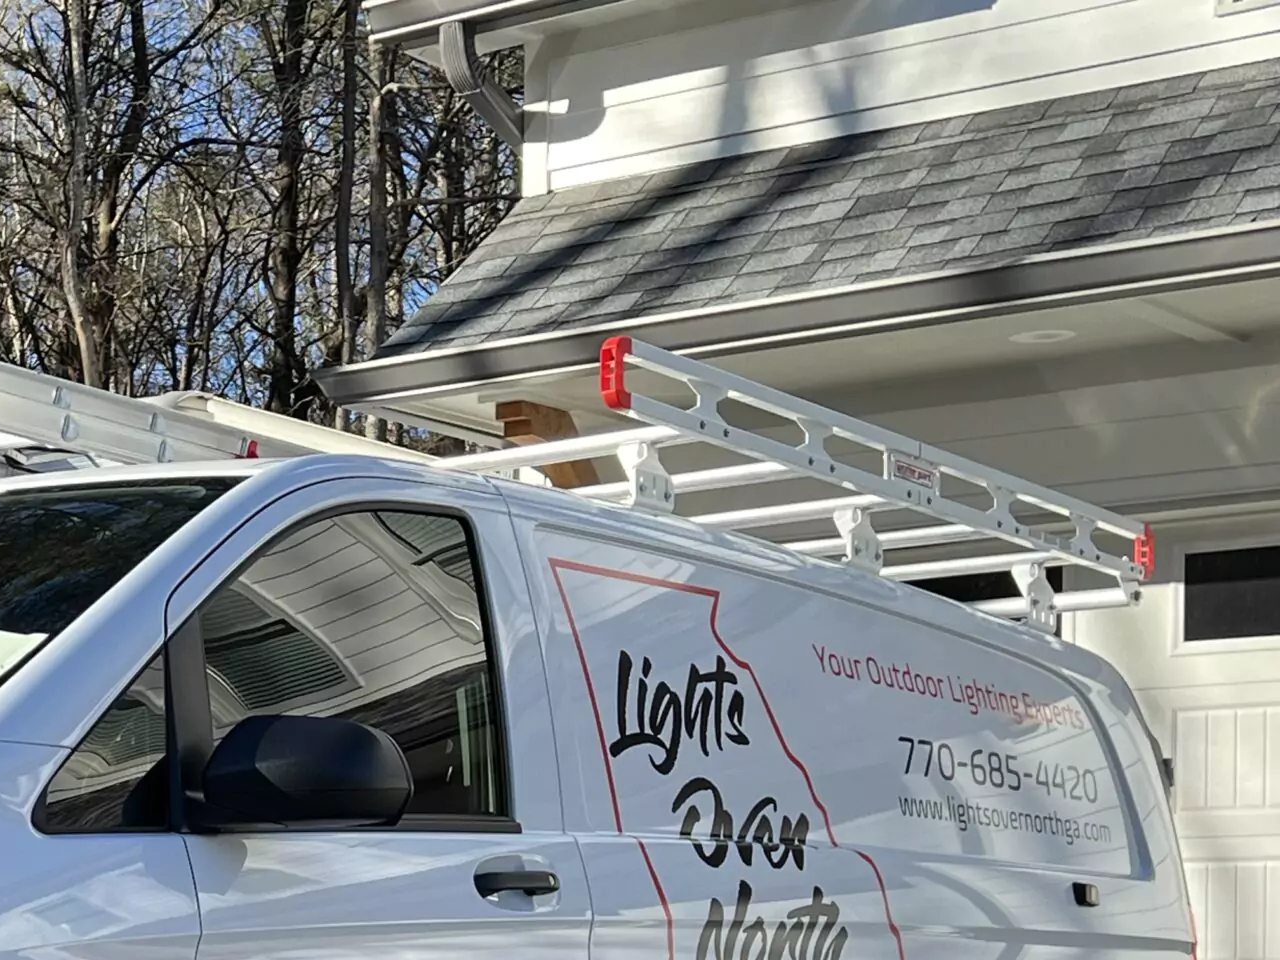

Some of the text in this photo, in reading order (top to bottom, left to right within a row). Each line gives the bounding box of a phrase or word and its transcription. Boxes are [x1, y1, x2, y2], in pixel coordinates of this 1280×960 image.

[609, 649, 751, 775] Lights
[812, 643, 1085, 730] Your Outdoor Lighting Experts
[898, 736, 1098, 803] 770-685-4420
[672, 777, 810, 871] Over
[898, 795, 1112, 846] www.lightsovernorthga.com
